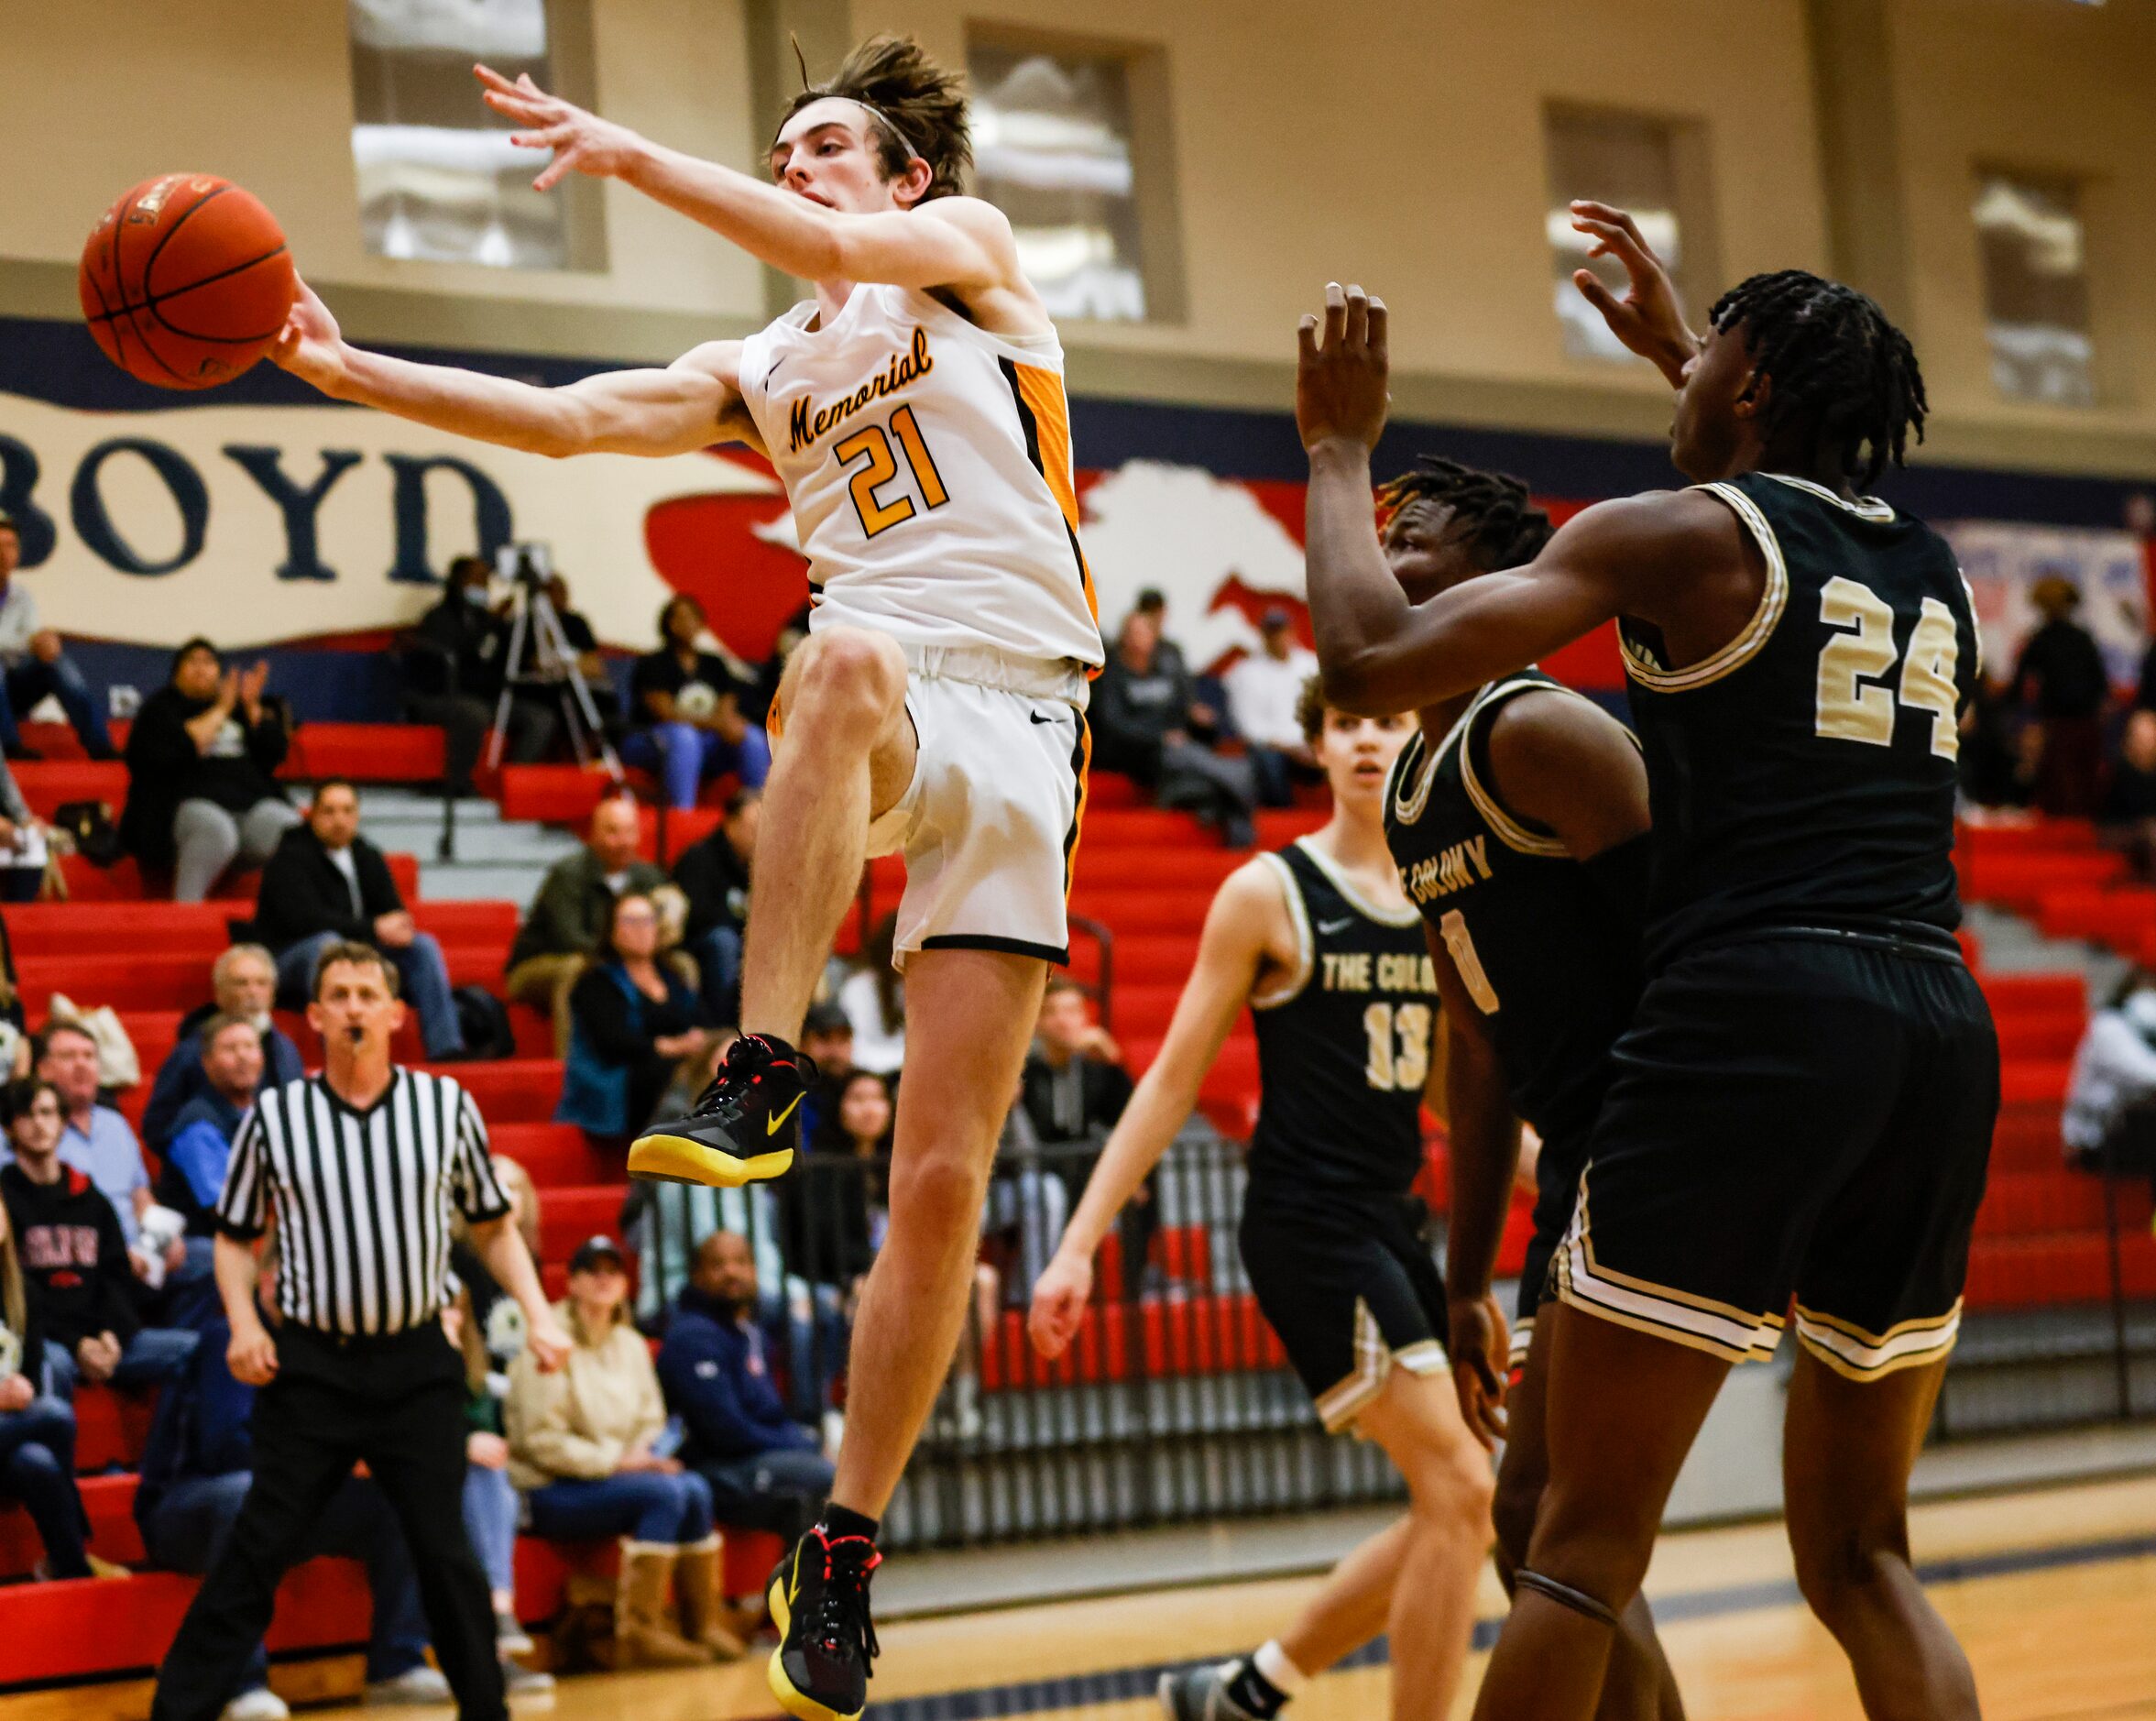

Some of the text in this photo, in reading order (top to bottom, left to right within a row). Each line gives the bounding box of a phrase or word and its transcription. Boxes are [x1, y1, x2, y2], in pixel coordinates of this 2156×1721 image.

[790, 323, 933, 454] Memorial
[832, 403, 950, 540] 21
[1815, 575, 1960, 762] 24
[1410, 834, 1494, 904] COLONY
[1321, 952, 1372, 992] THE
[1363, 1003, 1431, 1091] 13
